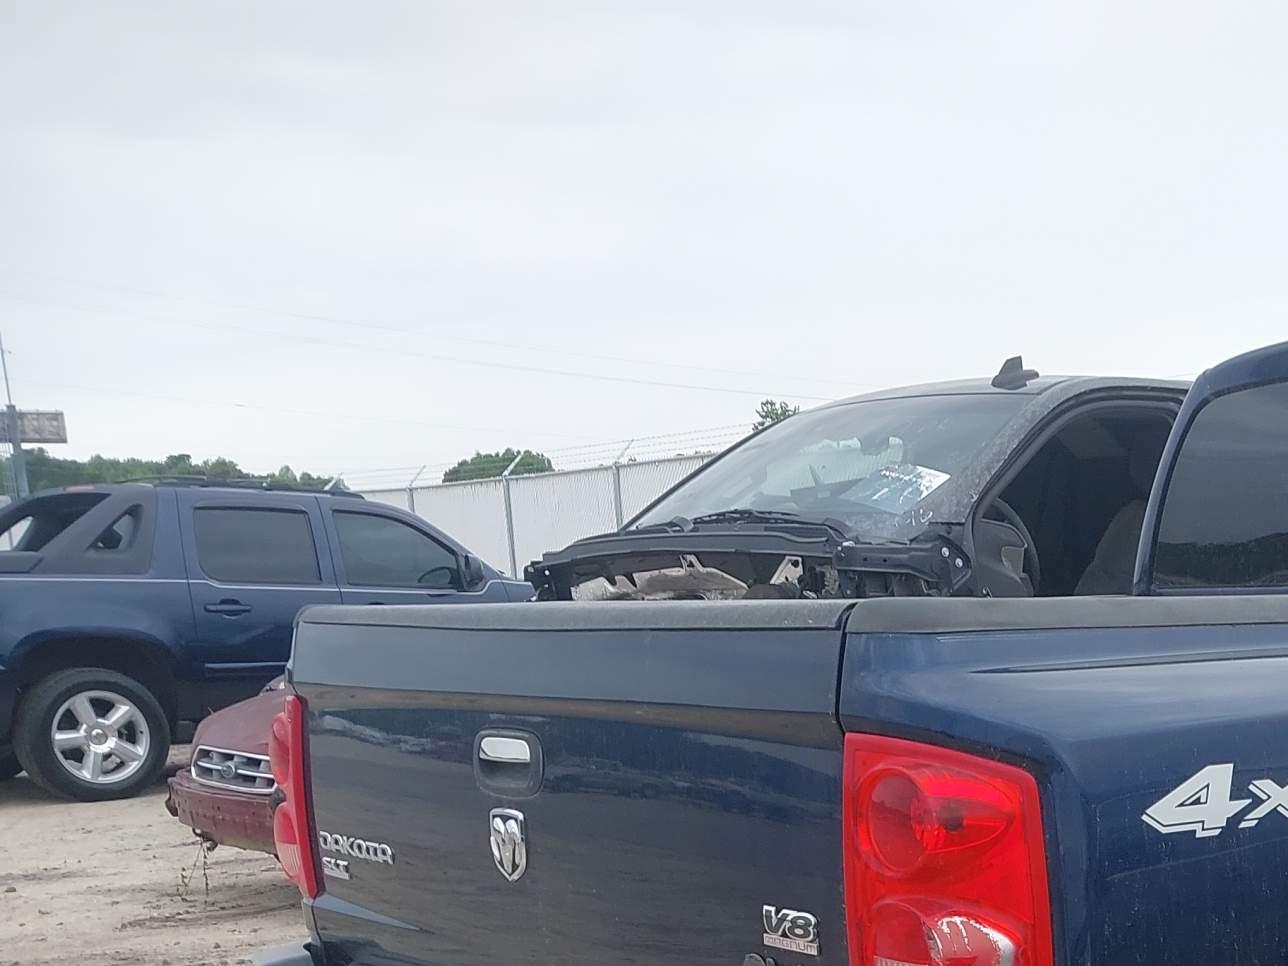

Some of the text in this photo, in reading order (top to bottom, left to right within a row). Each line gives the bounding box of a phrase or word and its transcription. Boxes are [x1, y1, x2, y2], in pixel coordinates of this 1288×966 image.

[319, 831, 395, 864] DAKOTA
[322, 857, 350, 877] SLT
[763, 905, 818, 942] V8
